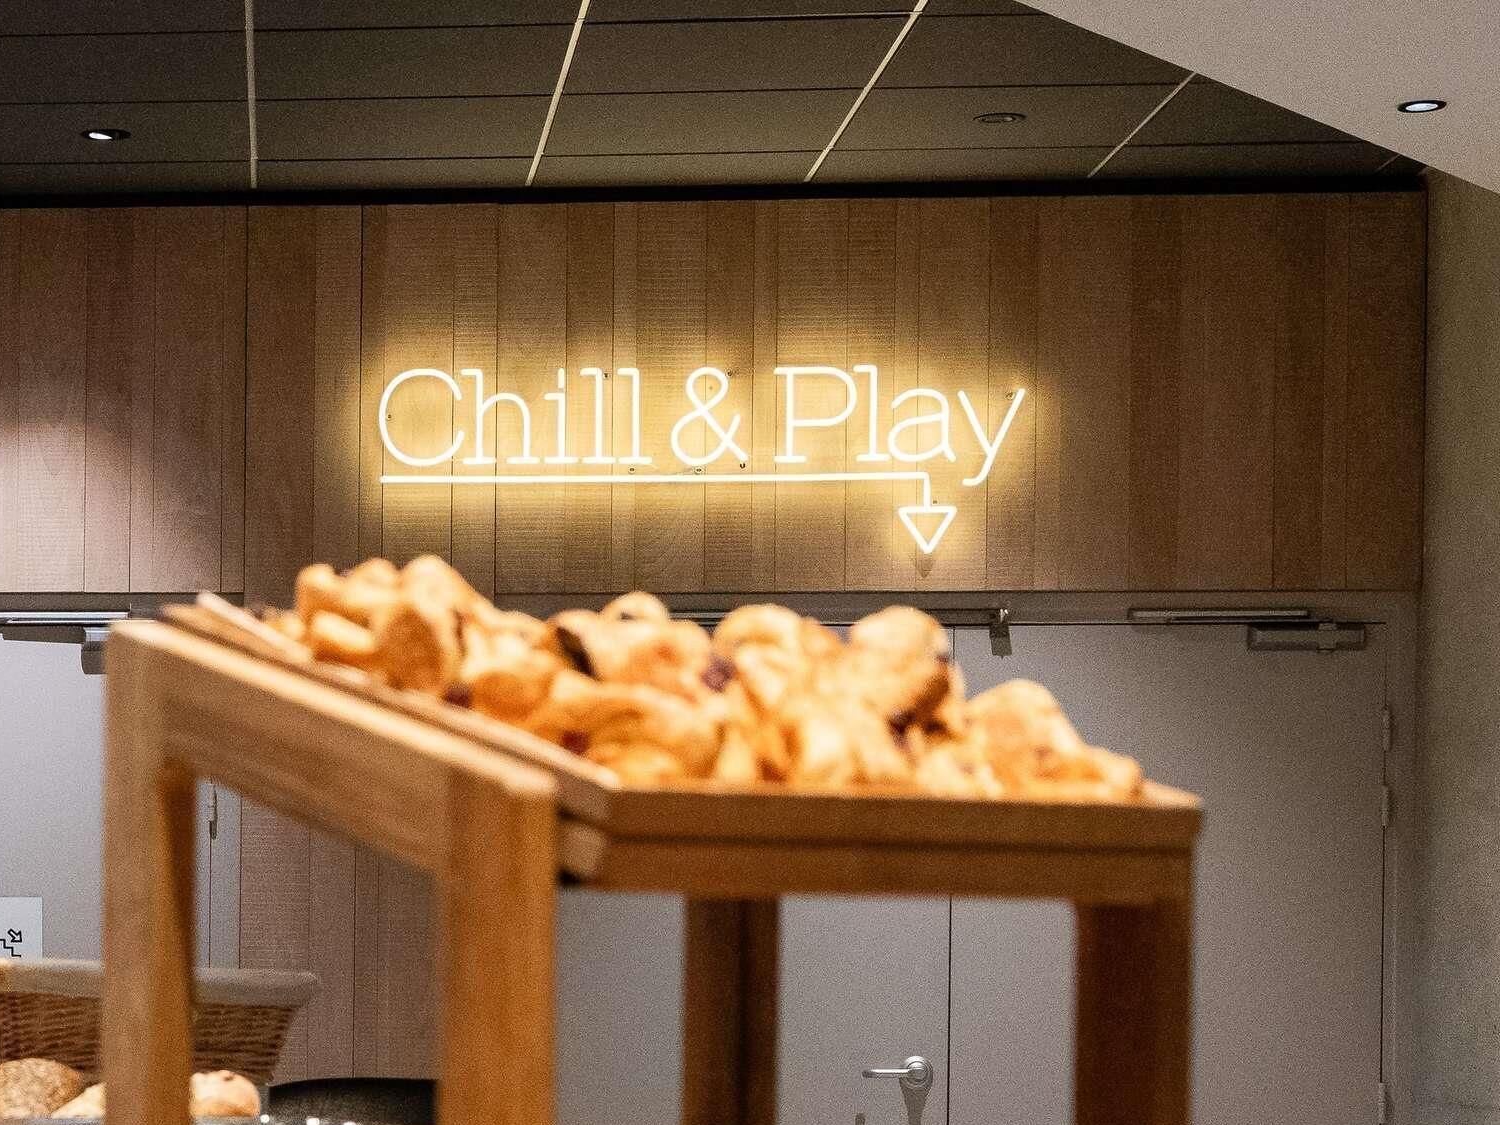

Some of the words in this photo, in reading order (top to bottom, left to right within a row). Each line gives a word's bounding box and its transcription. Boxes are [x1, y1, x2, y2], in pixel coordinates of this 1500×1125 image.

[378, 367, 653, 467] Chill
[670, 366, 749, 468] &
[773, 364, 1027, 487] Play
